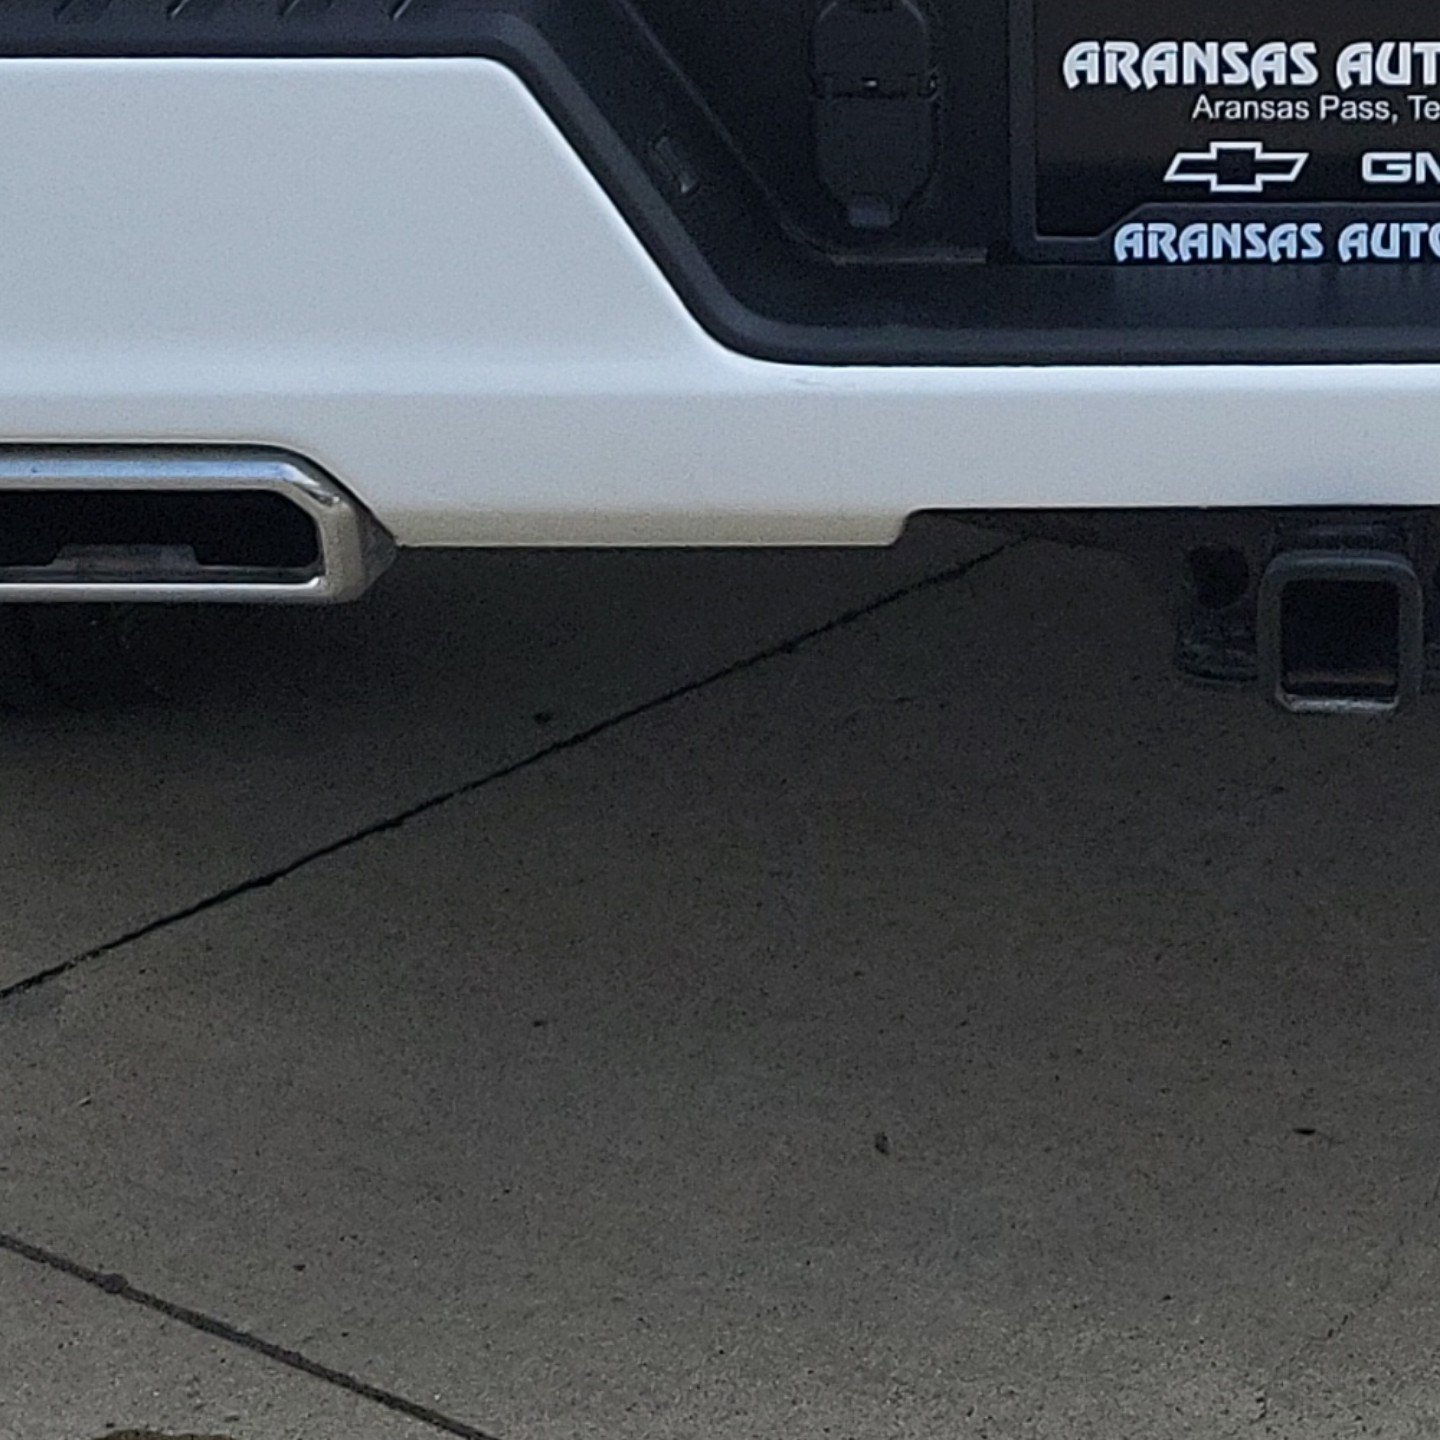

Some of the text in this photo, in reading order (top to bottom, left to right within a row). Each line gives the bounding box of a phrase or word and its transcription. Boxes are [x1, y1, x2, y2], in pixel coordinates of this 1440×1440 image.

[1062, 41, 1320, 91] ARANSAS
[1192, 94, 1310, 121] Aransas
[1320, 95, 1399, 124] Pass,
[1113, 222, 1324, 263] ARANSAS
